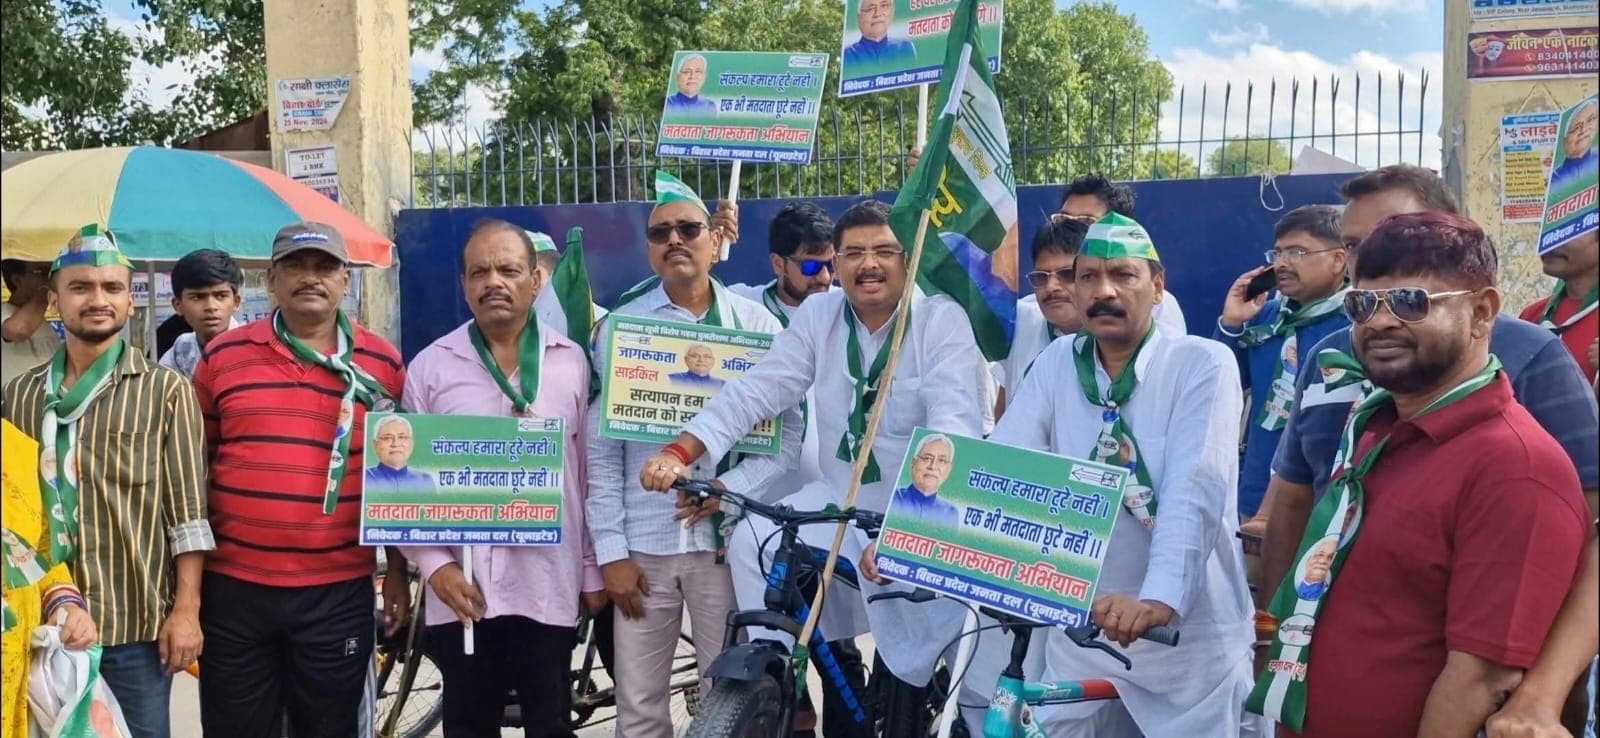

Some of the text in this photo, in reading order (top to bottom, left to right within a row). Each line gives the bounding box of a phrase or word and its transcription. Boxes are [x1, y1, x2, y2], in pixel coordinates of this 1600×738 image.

[909, 16, 939, 35] मतदाता
[1506, 34, 1598, 50] जीवन एक नाटक
[720, 72, 749, 86] संकल्प
[750, 74, 777, 87] हमारा
[778, 72, 791, 92] टूटे
[720, 98, 734, 112] एक
[734, 95, 746, 112] भी
[746, 99, 775, 113] मतदाता
[776, 97, 789, 119] छूटे
[789, 97, 809, 113] नहीं
[663, 124, 810, 143] मतदाता जागरूकता अभियान
[1547, 187, 1596, 223] मतदाता
[617, 346, 677, 364] जागरूकता
[614, 365, 659, 383] साइकिल
[630, 388, 705, 408] सत्यापन हम
[612, 403, 658, 420] मतदान
[660, 406, 678, 422] को
[432, 437, 470, 454] संकल्प
[473, 440, 506, 455] हमारा
[509, 437, 524, 461] टूटे
[526, 437, 551, 455] नहीं
[439, 470, 456, 486] एक
[457, 466, 471, 486] भी
[472, 471, 509, 487] मतदाता
[511, 467, 526, 494] छूटे
[528, 467, 550, 487] नहीं
[969, 467, 1011, 494] संकल्प
[1011, 480, 1051, 503] हमारा
[1050, 486, 1071, 514] टूटे
[1071, 493, 1105, 516] नहीं
[367, 500, 558, 521] मतदाता जागरूकता अभियान
[366, 528, 403, 541] निवेदक
[409, 528, 437, 541] बिहार
[438, 529, 461, 541] प्रदेश
[463, 530, 491, 541] जनता
[492, 530, 509, 541] दल
[511, 529, 558, 544] (यूनाइटेड)
[964, 506, 985, 526] एक
[984, 508, 1001, 532] भी
[1000, 516, 1044, 544] मतदाता
[1041, 523, 1064, 555] छूटे
[1063, 530, 1092, 555] नहीं
[883, 528, 1091, 601] मतदाता जागरूकता अभियान
[877, 556, 910, 576] निवेदक
[915, 566, 945, 586] बिहार
[943, 575, 970, 593] प्रदेश
[969, 583, 1003, 601] जनता
[1002, 593, 1024, 609] दल
[1023, 598, 1083, 628] (यूनाइटेड)
